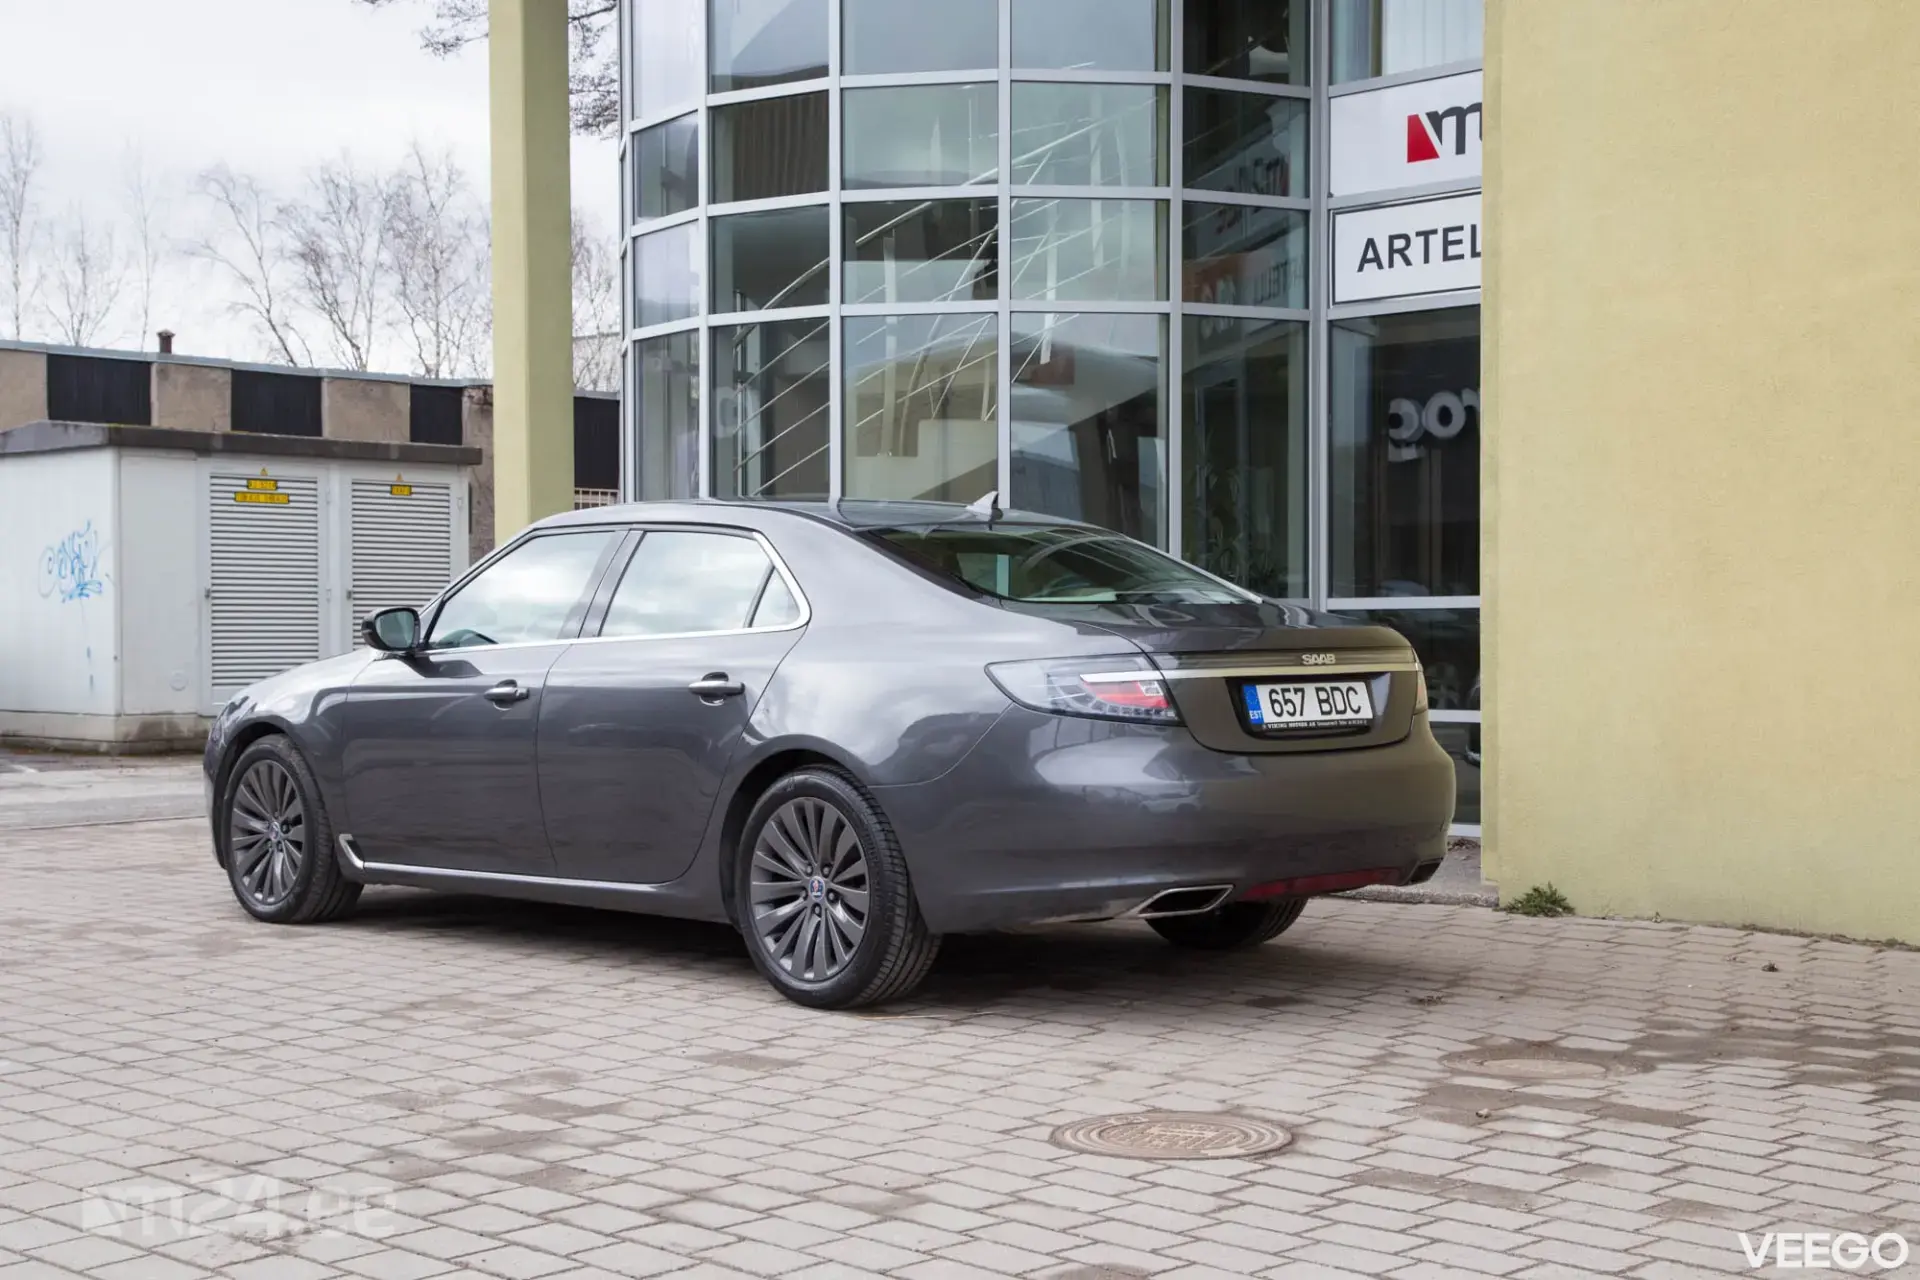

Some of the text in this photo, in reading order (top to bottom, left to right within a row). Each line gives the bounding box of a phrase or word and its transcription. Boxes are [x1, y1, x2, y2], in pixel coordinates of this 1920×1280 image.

[1357, 224, 1481, 273] ARTEL
[1302, 653, 1336, 665] SAAB
[1268, 686, 1361, 717] 657 BDC
[1250, 710, 1263, 719] EST
